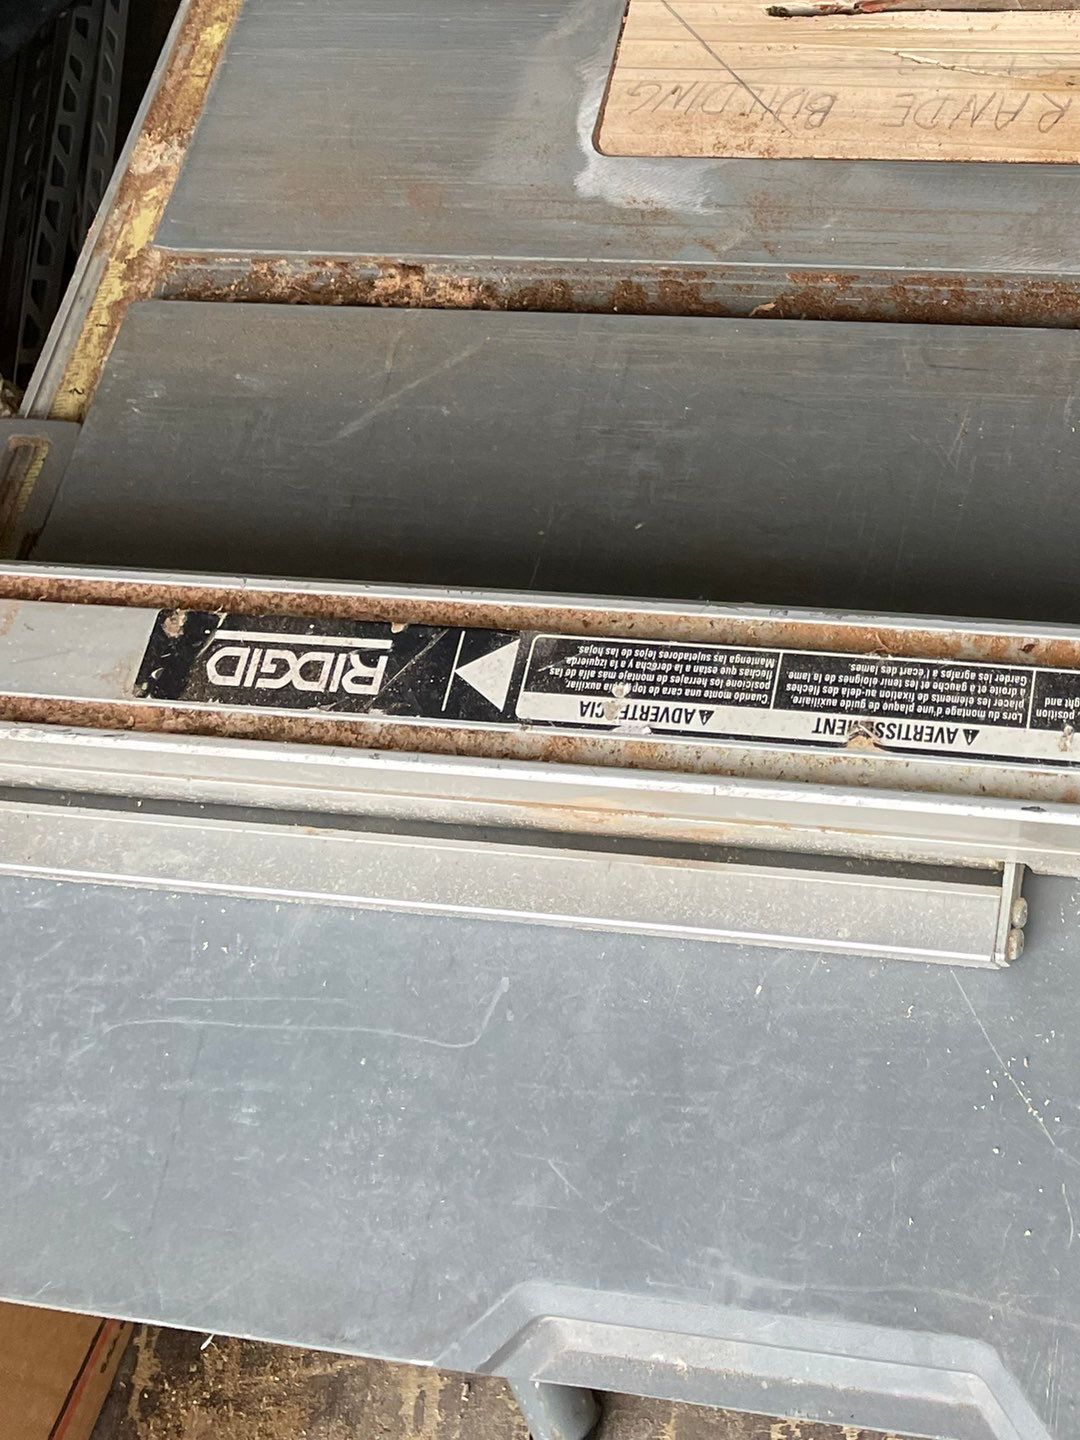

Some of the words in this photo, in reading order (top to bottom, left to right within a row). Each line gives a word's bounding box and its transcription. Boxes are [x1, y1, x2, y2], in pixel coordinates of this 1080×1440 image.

[624, 79, 836, 130] BUILDING
[576, 643, 603, 656] hojas.
[605, 647, 618, 657] las
[620, 648, 632, 658] de
[634, 646, 656, 659] lejos
[658, 648, 711, 663] sujetadores
[712, 654, 727, 664] las
[728, 653, 774, 668] Mantenga
[205, 644, 388, 695] RIDGID
[609, 659, 618, 669] la
[635, 660, 672, 672] derecha
[672, 663, 683, 673] la
[719, 664, 737, 674] que
[848, 663, 878, 674] lames.
[549, 666, 563, 677] las
[565, 668, 576, 678] de
[738, 667, 772, 679] flechas
[880, 665, 897, 676] des
[937, 667, 976, 681] agrafes
[617, 670, 654, 683] montaje
[656, 674, 668, 684] de
[669, 673, 707, 687] herrajes
[812, 672, 822, 682] la
[823, 673, 836, 683] de
[977, 672, 992, 682] les
[994, 673, 1027, 685] Garder
[709, 677, 723, 688] los
[725, 677, 770, 691] posicione
[879, 677, 902, 688] tenir
[904, 679, 918, 689] les
[920, 680, 929, 689] et
[932, 679, 967, 693] gauche
[648, 685, 660, 696] de
[661, 686, 682, 696] cara
[684, 687, 701, 697] una
[703, 689, 731, 699] monte
[821, 685, 839, 696] des
[977, 684, 986, 694] et
[989, 685, 1017, 697] droite
[733, 691, 767, 704] Cuando
[879, 689, 914, 701] fixation
[916, 692, 929, 703] de
[839, 697, 866, 711] guide
[867, 701, 880, 712] de
[881, 700, 914, 714] plaque
[976, 697, 990, 708] les
[992, 696, 1024, 710] placer
[1044, 697, 1062, 707] and
[578, 700, 696, 725] ADVERTECIA
[944, 705, 985, 719] montage
[987, 710, 999, 721] du
[1002, 711, 1022, 723] Lors
[1035, 707, 1075, 722] position
